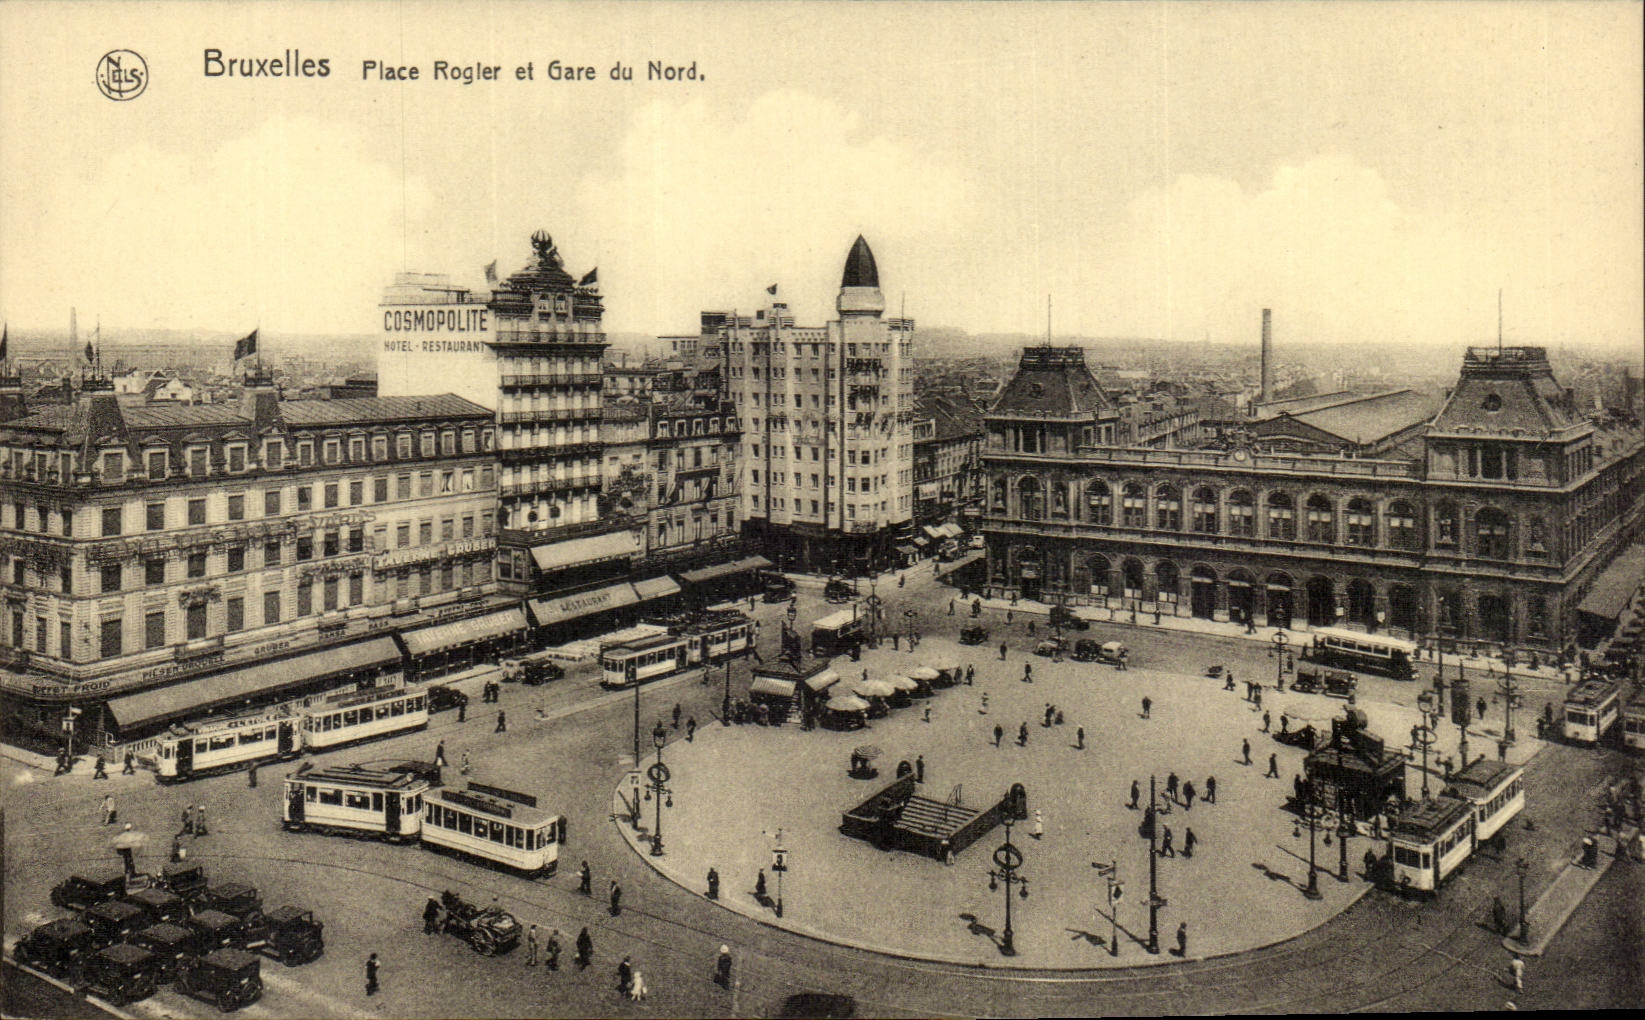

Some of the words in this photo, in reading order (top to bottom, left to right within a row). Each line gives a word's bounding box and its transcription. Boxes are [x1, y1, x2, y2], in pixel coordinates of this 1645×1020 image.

[384, 309, 488, 332] COSMOPOLITE
[384, 340, 413, 352] HOTEL
[421, 340, 486, 352] RESTAURANT
[447, 537, 497, 556] GRUBER
[415, 621, 468, 645] TAVERNE
[471, 610, 515, 631] GRUBER
[254, 640, 291, 656] GRUBER
